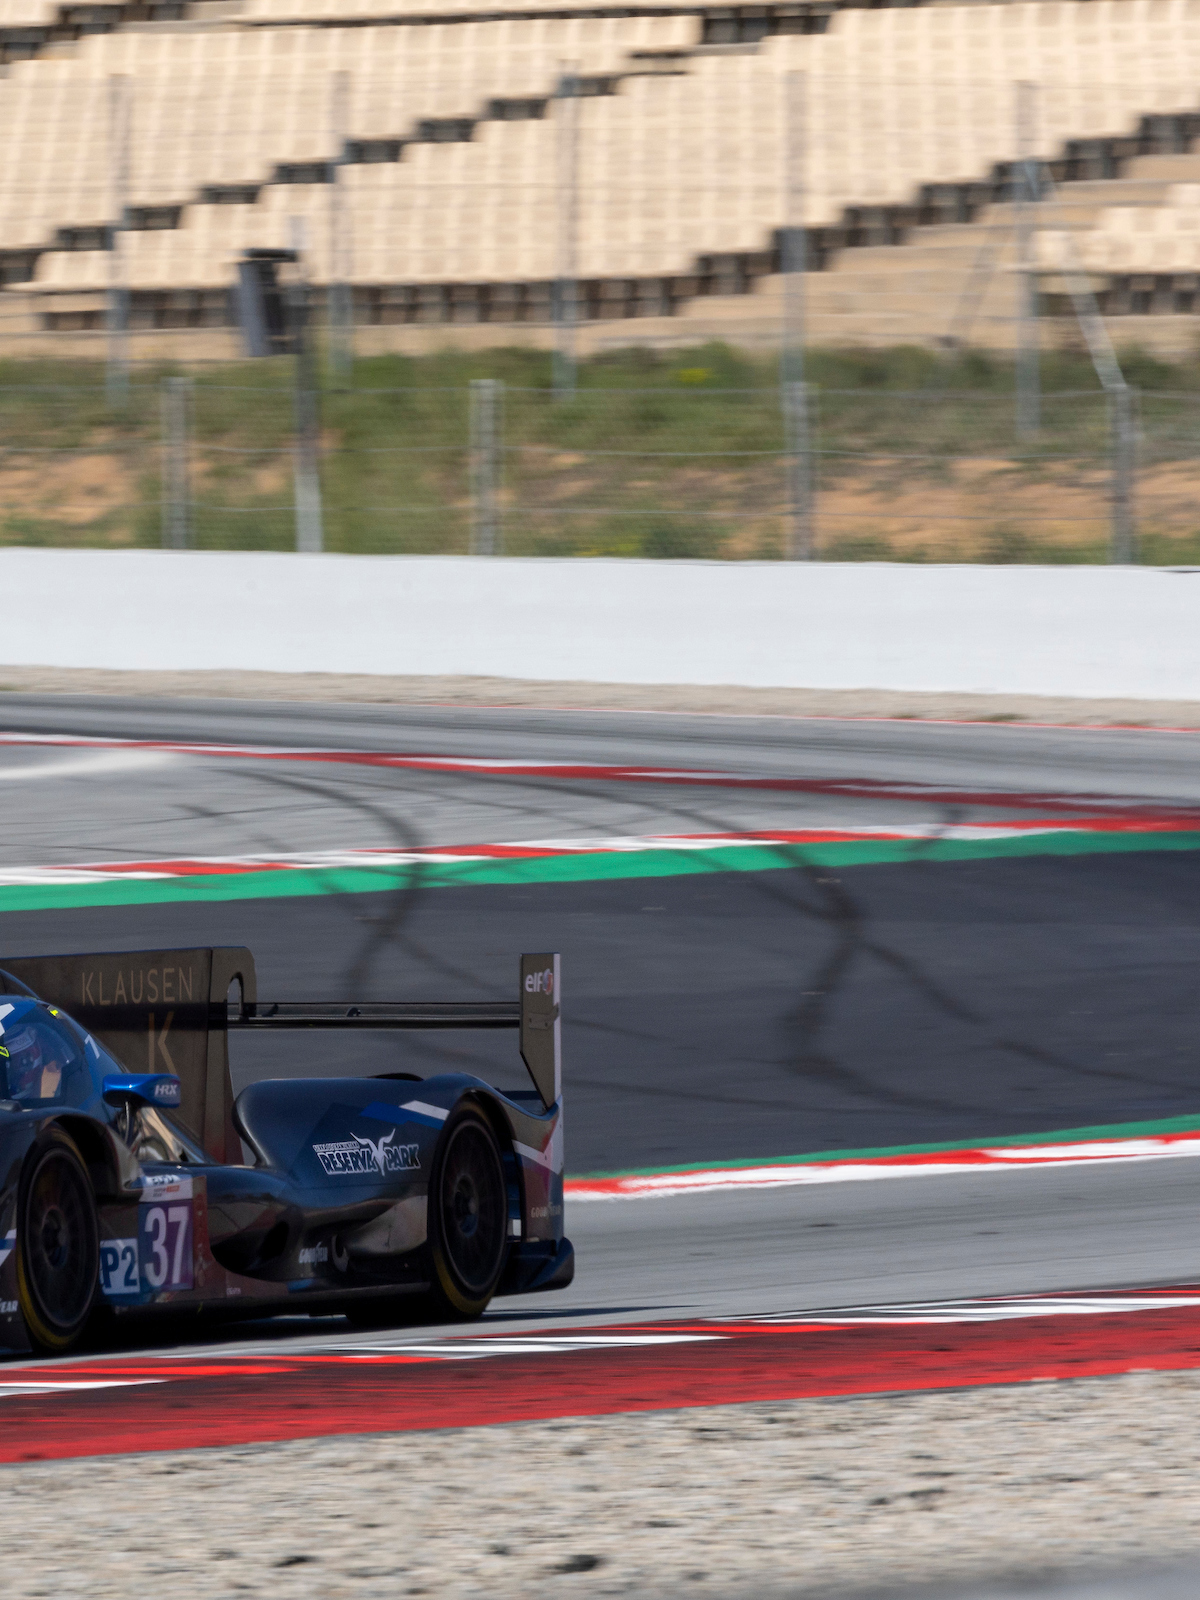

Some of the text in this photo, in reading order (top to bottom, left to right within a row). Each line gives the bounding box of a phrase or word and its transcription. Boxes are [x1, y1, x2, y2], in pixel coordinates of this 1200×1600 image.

[81, 966, 193, 1006] KLAUSEN
[524, 972, 543, 993] elf
[148, 1011, 177, 1074] K
[154, 1084, 178, 1096] HRX
[316, 1143, 421, 1175] RESERVA PARK
[100, 1245, 138, 1288] P2
[144, 1206, 188, 1287] 37
